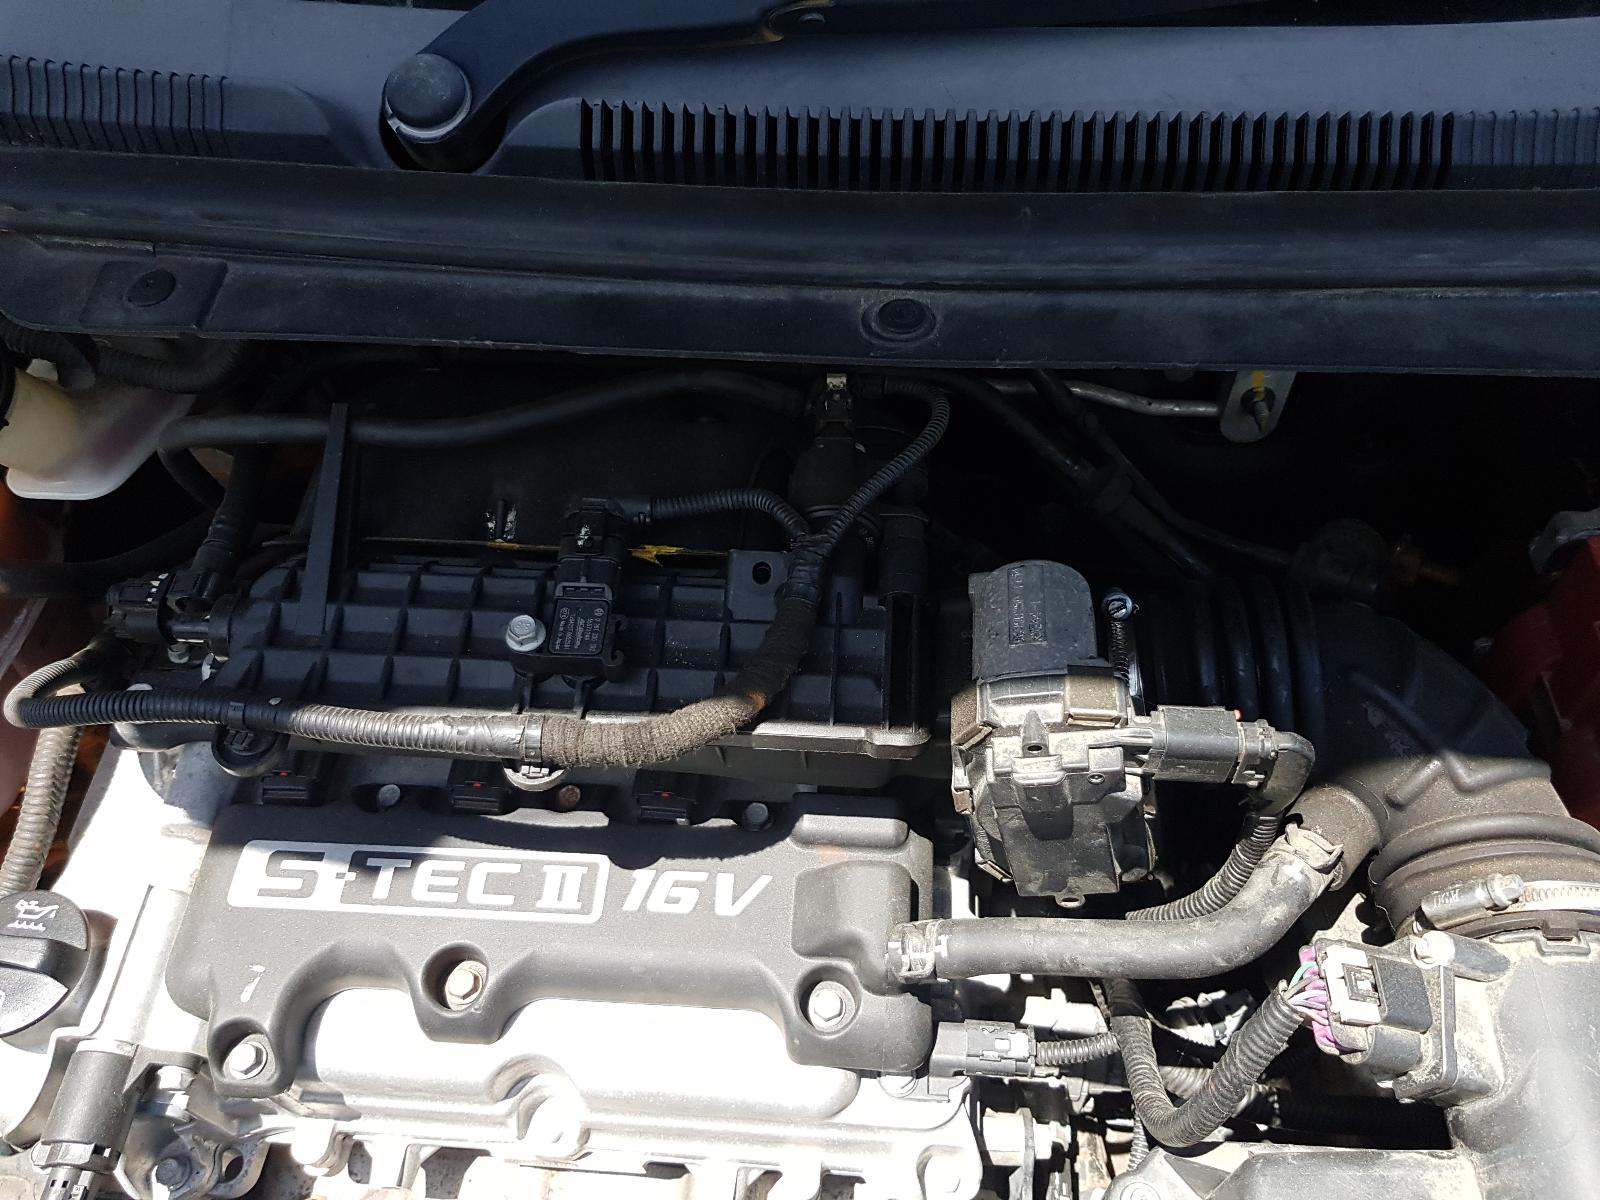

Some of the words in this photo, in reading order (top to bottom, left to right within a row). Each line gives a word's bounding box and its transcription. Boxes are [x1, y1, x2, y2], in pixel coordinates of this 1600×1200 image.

[256, 850, 522, 906] S-TEC
[535, 865, 588, 911] II
[622, 869, 773, 917] 16V
